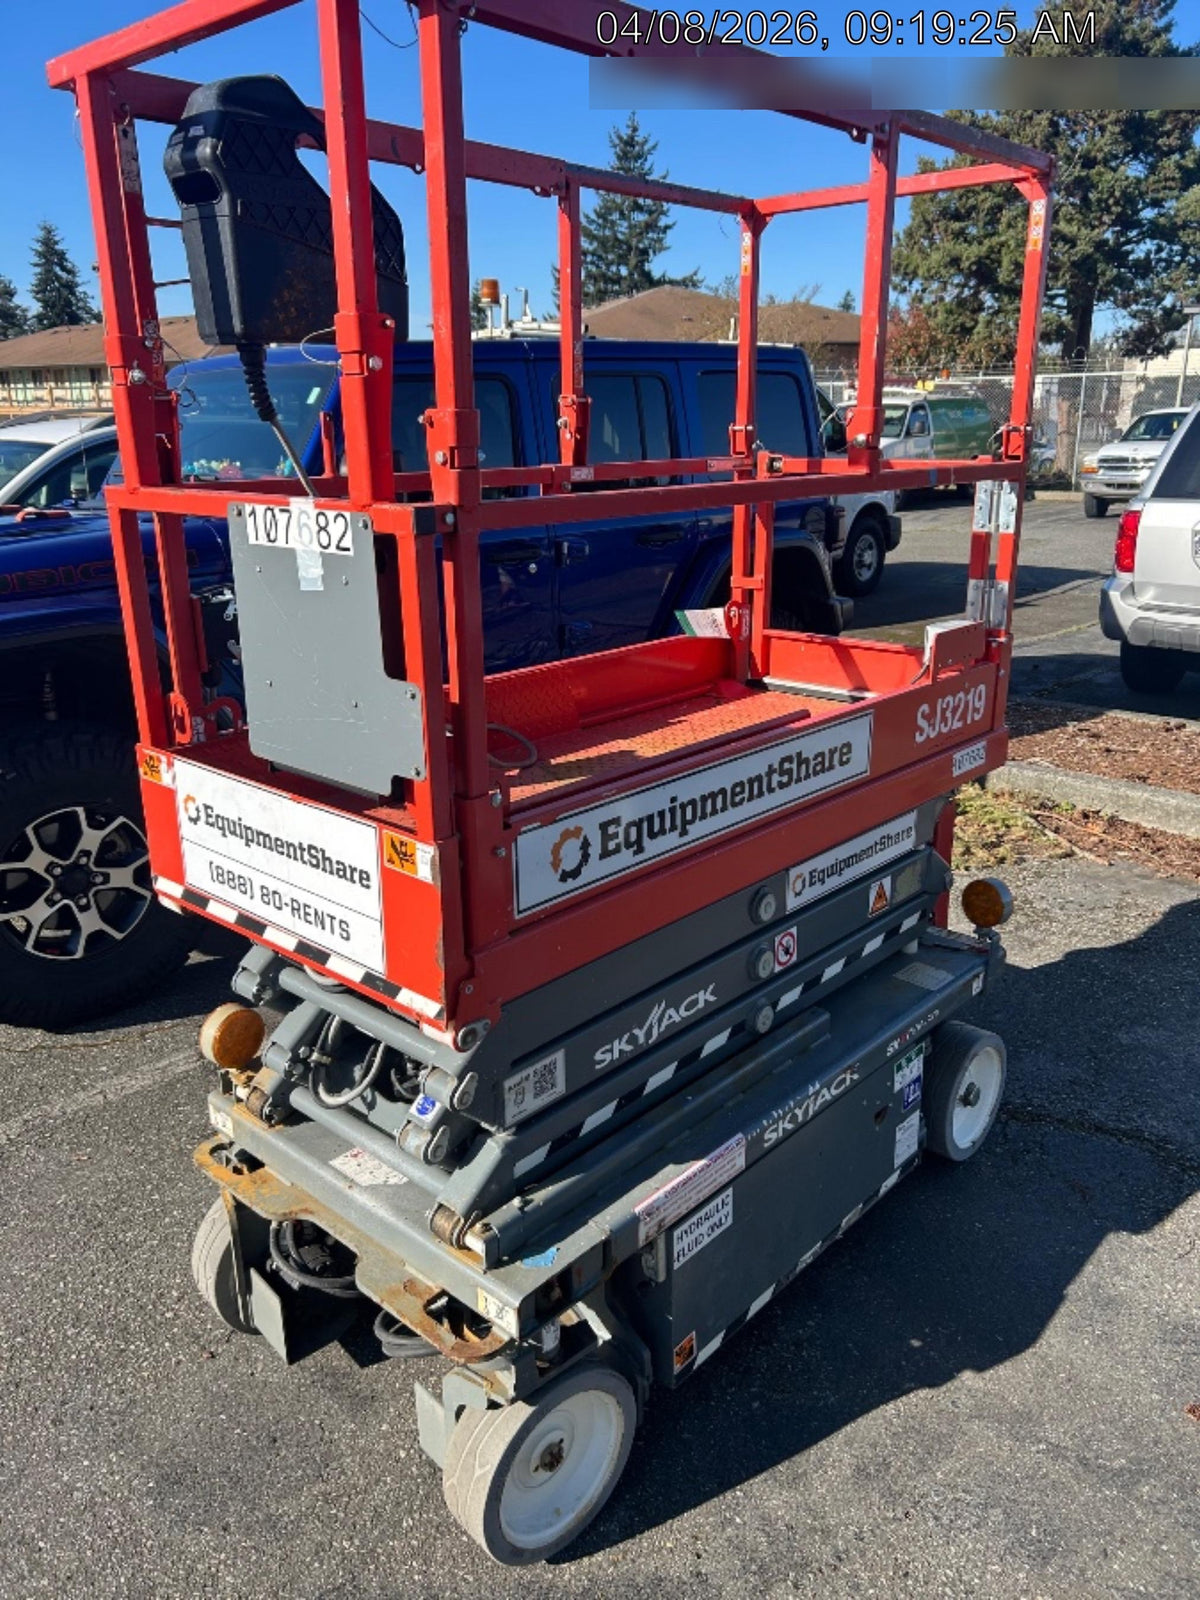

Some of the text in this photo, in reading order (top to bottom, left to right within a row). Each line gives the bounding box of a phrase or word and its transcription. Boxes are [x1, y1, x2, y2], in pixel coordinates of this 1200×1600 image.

[247, 505, 352, 551] 107682
[914, 684, 987, 744] SJ3219
[598, 738, 853, 860] EquipmentShare
[203, 803, 372, 890] EquipmentShare
[807, 824, 915, 888] EquipmentShare
[208, 860, 352, 942] (888) 80-RENTS
[593, 982, 717, 1069] SKYJACK
[762, 1067, 860, 1148] SKYJACK
[676, 1193, 731, 1246] HYDRAULIC
[676, 1210, 731, 1263] FLUID ONLY
